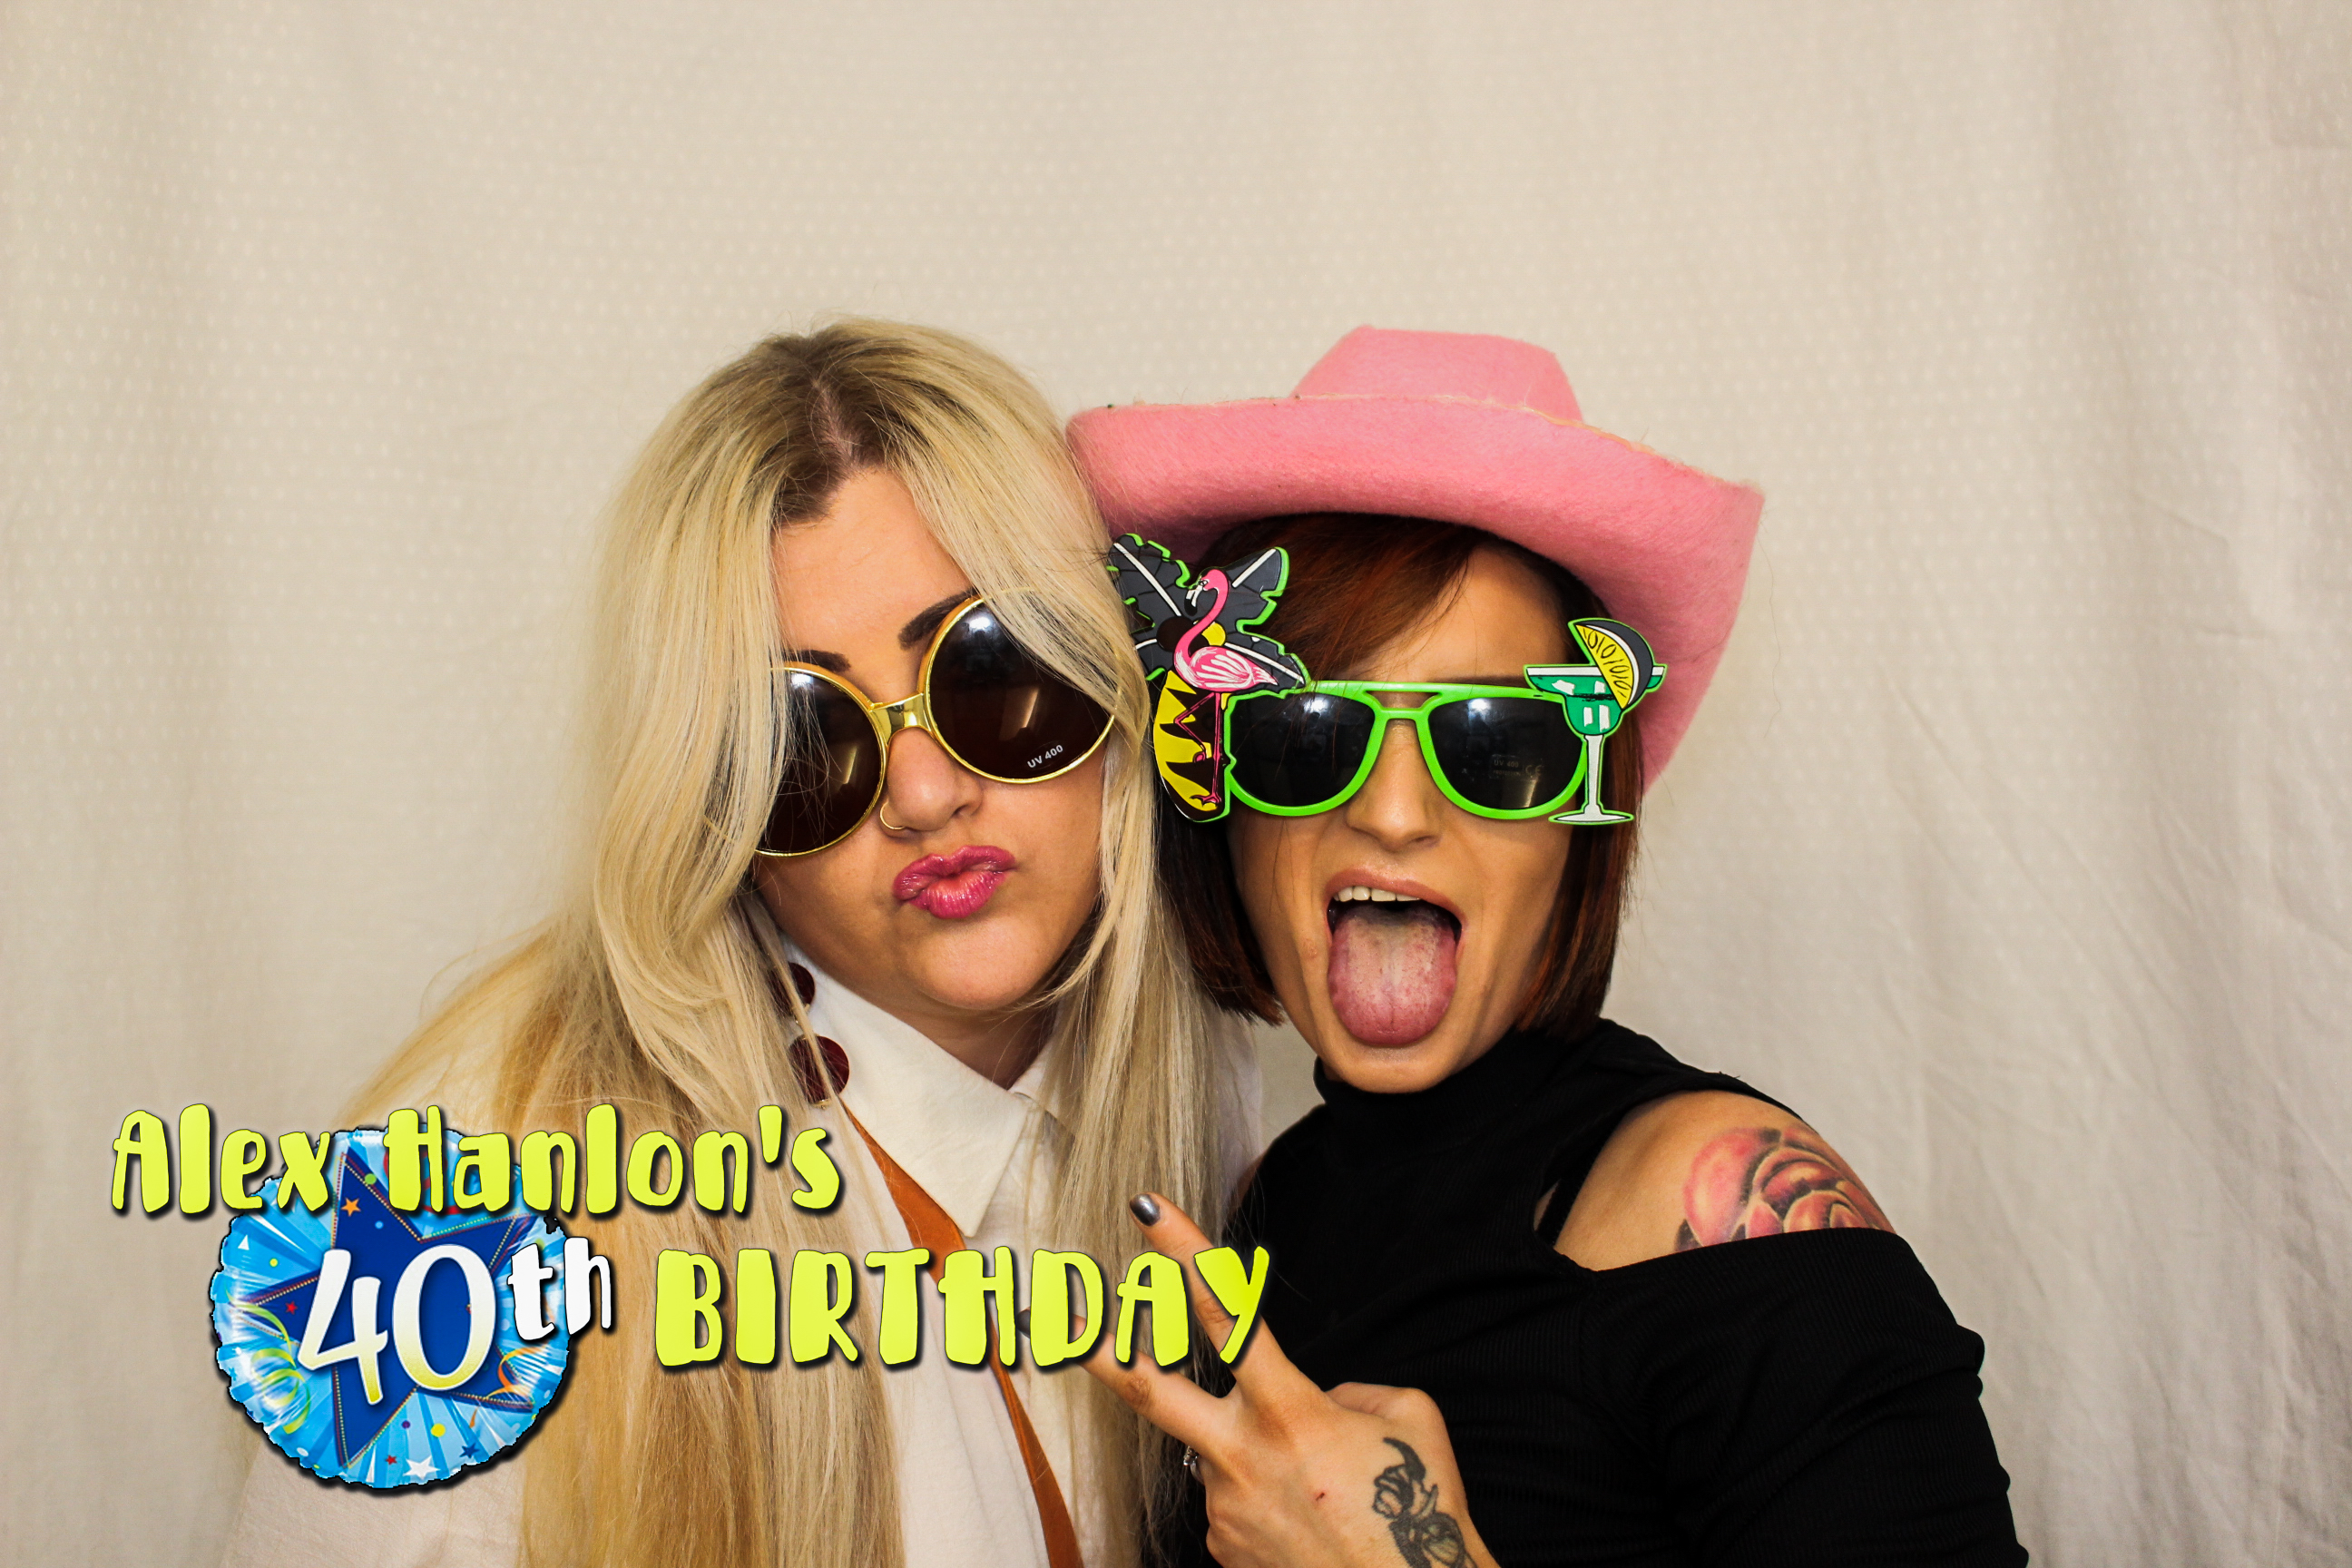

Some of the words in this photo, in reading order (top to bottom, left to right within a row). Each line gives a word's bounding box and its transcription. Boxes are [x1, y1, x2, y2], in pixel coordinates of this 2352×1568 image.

[1026, 755, 1043, 769] UV
[1044, 744, 1063, 760] 400
[1493, 759, 1504, 767] UV
[1506, 760, 1519, 769] 400
